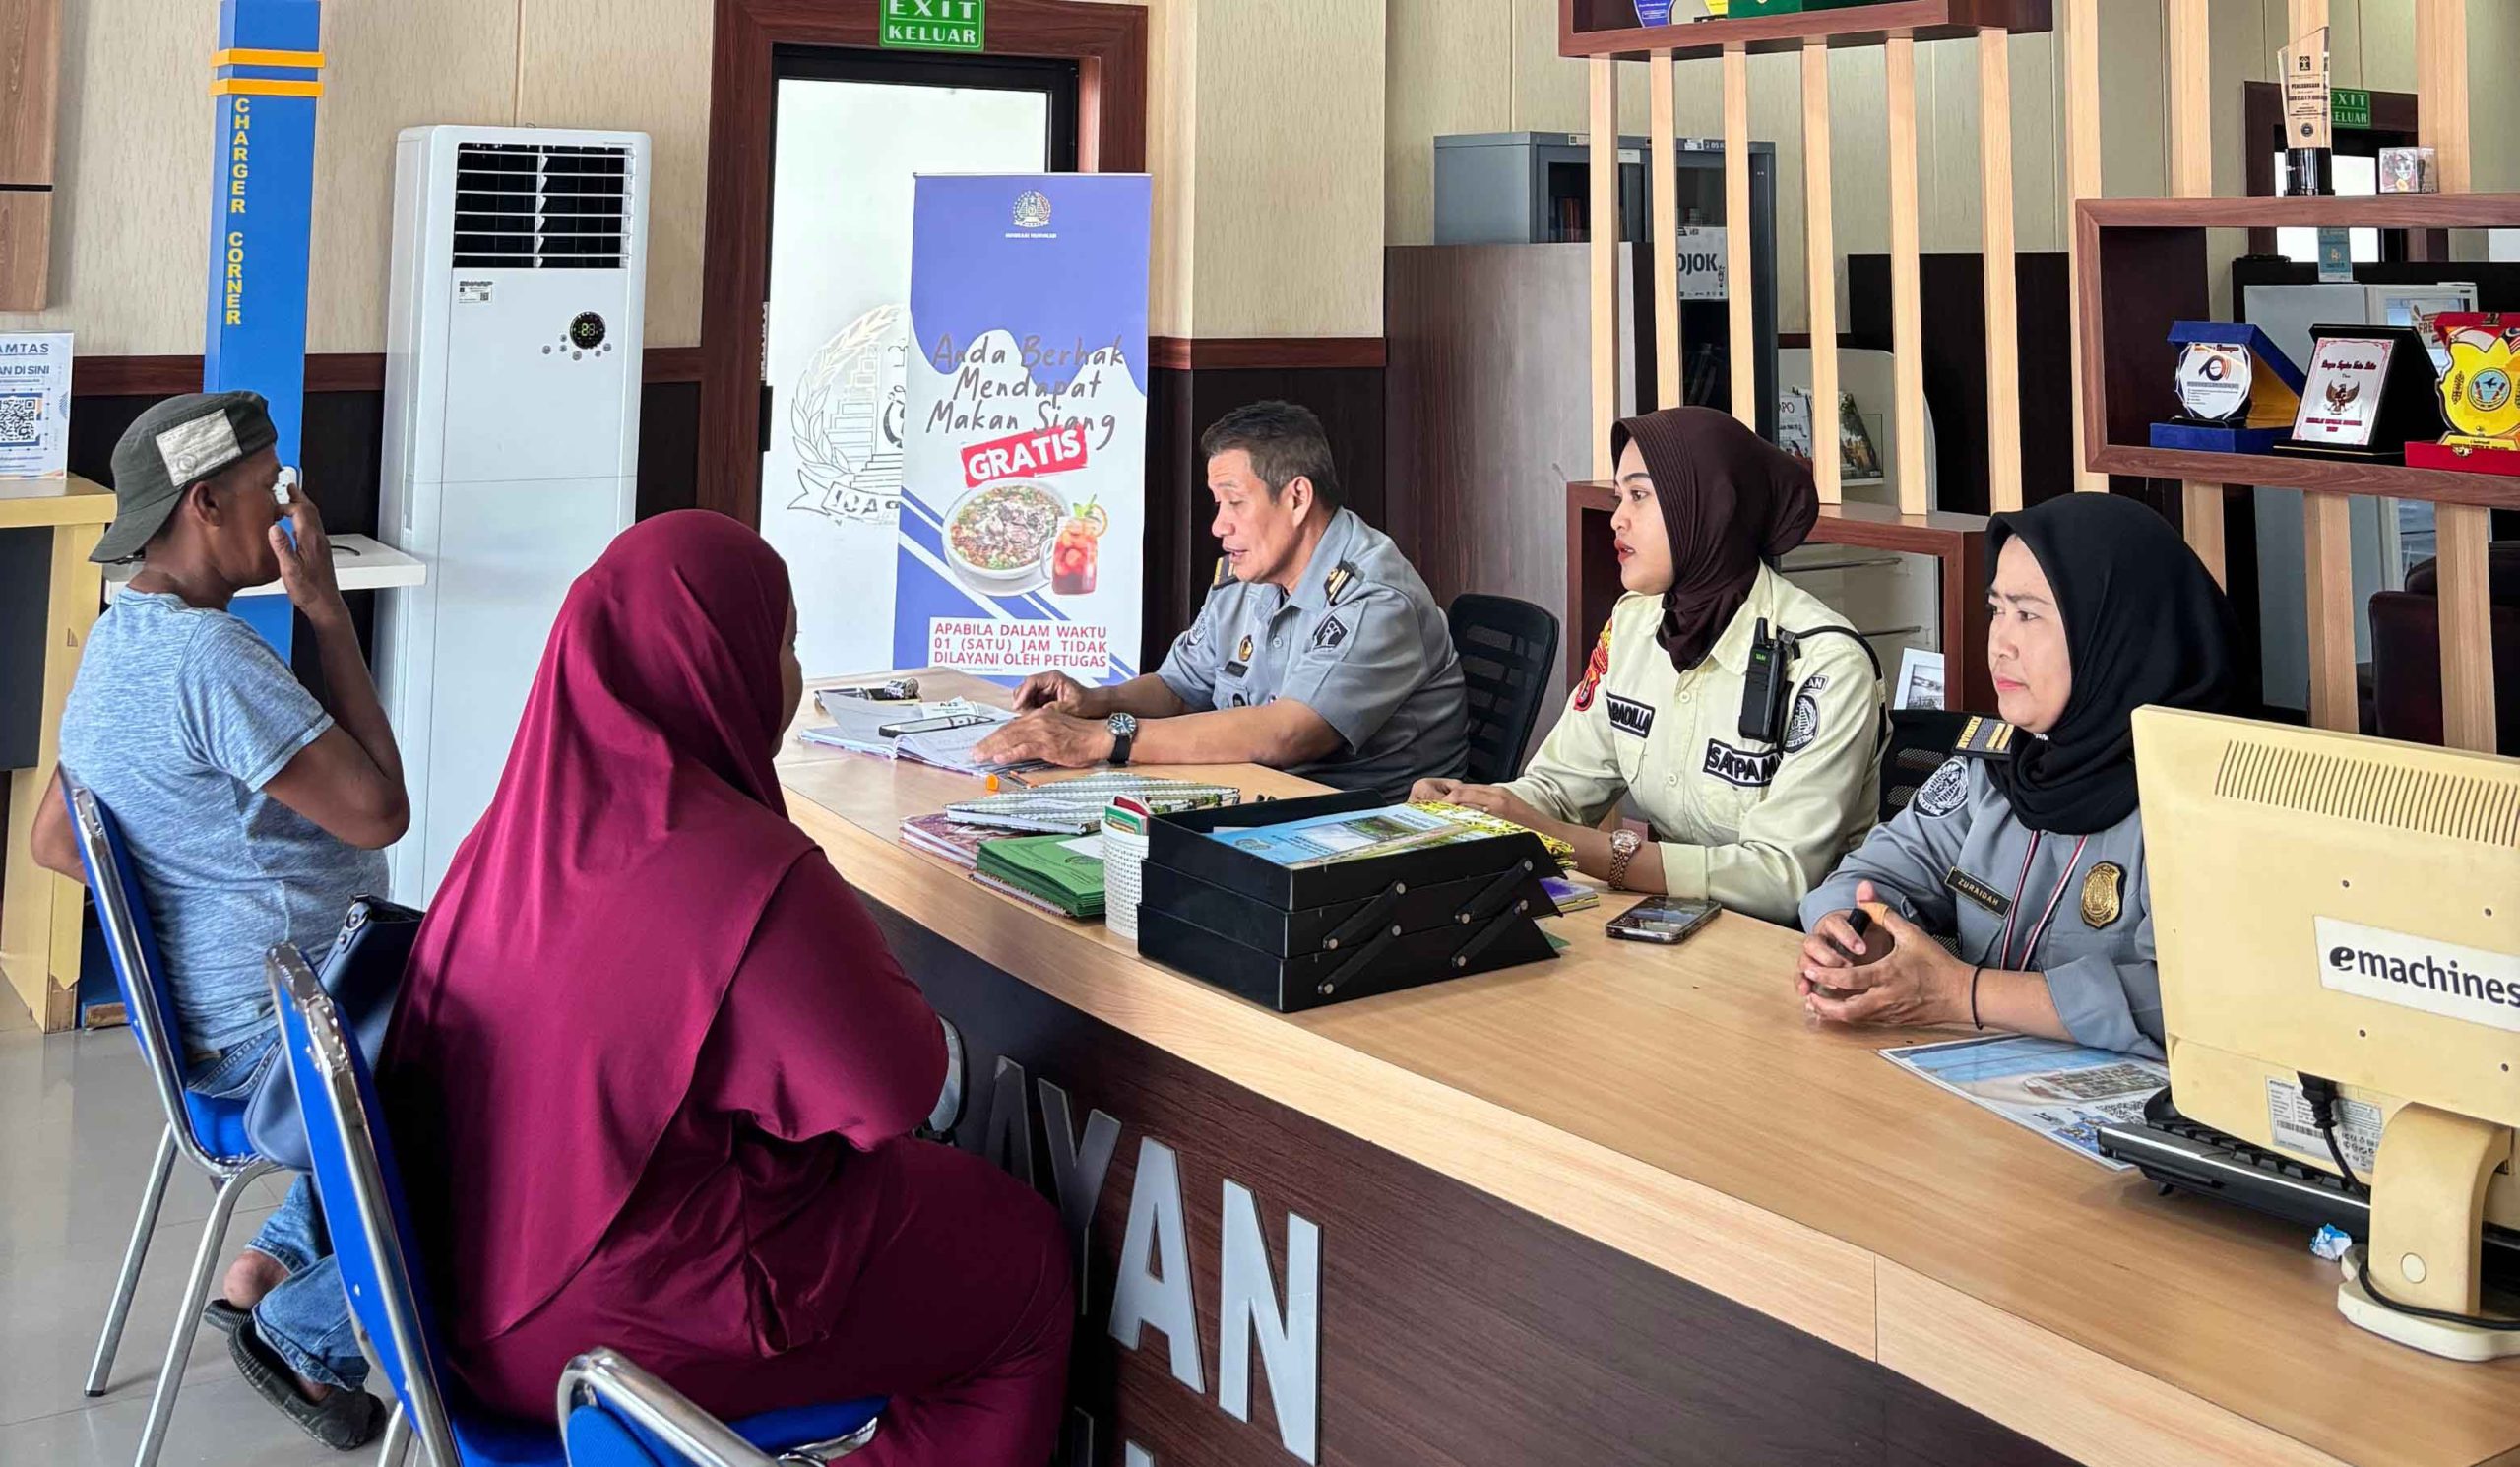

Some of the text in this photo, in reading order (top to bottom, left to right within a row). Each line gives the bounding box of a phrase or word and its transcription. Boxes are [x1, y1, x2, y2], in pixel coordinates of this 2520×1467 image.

[889, 0, 976, 18] EXIT
[889, 25, 976, 43] KELUAR
[225, 97, 250, 325] CHARGER CORNER
[1677, 252, 1719, 275] OJOK
[932, 333, 1124, 369] Anda Berhak
[15, 365, 26, 375] DI
[27, 365, 50, 375] SINI
[952, 366, 1102, 409] Mendapat
[925, 398, 1115, 451] Makan Siang
[968, 430, 1081, 480] GRATIS
[934, 623, 1106, 639] APABILA DALAM WAKTU
[934, 638, 1107, 653] 01 (SATU) JAM TIDAK
[934, 652, 1106, 668] DILAYANI OLEH PETUGAS
[1958, 878, 1999, 907] ZURAIDAH
[2329, 946, 2520, 1008] emachines
[984, 1053, 1323, 1467] AYAN
